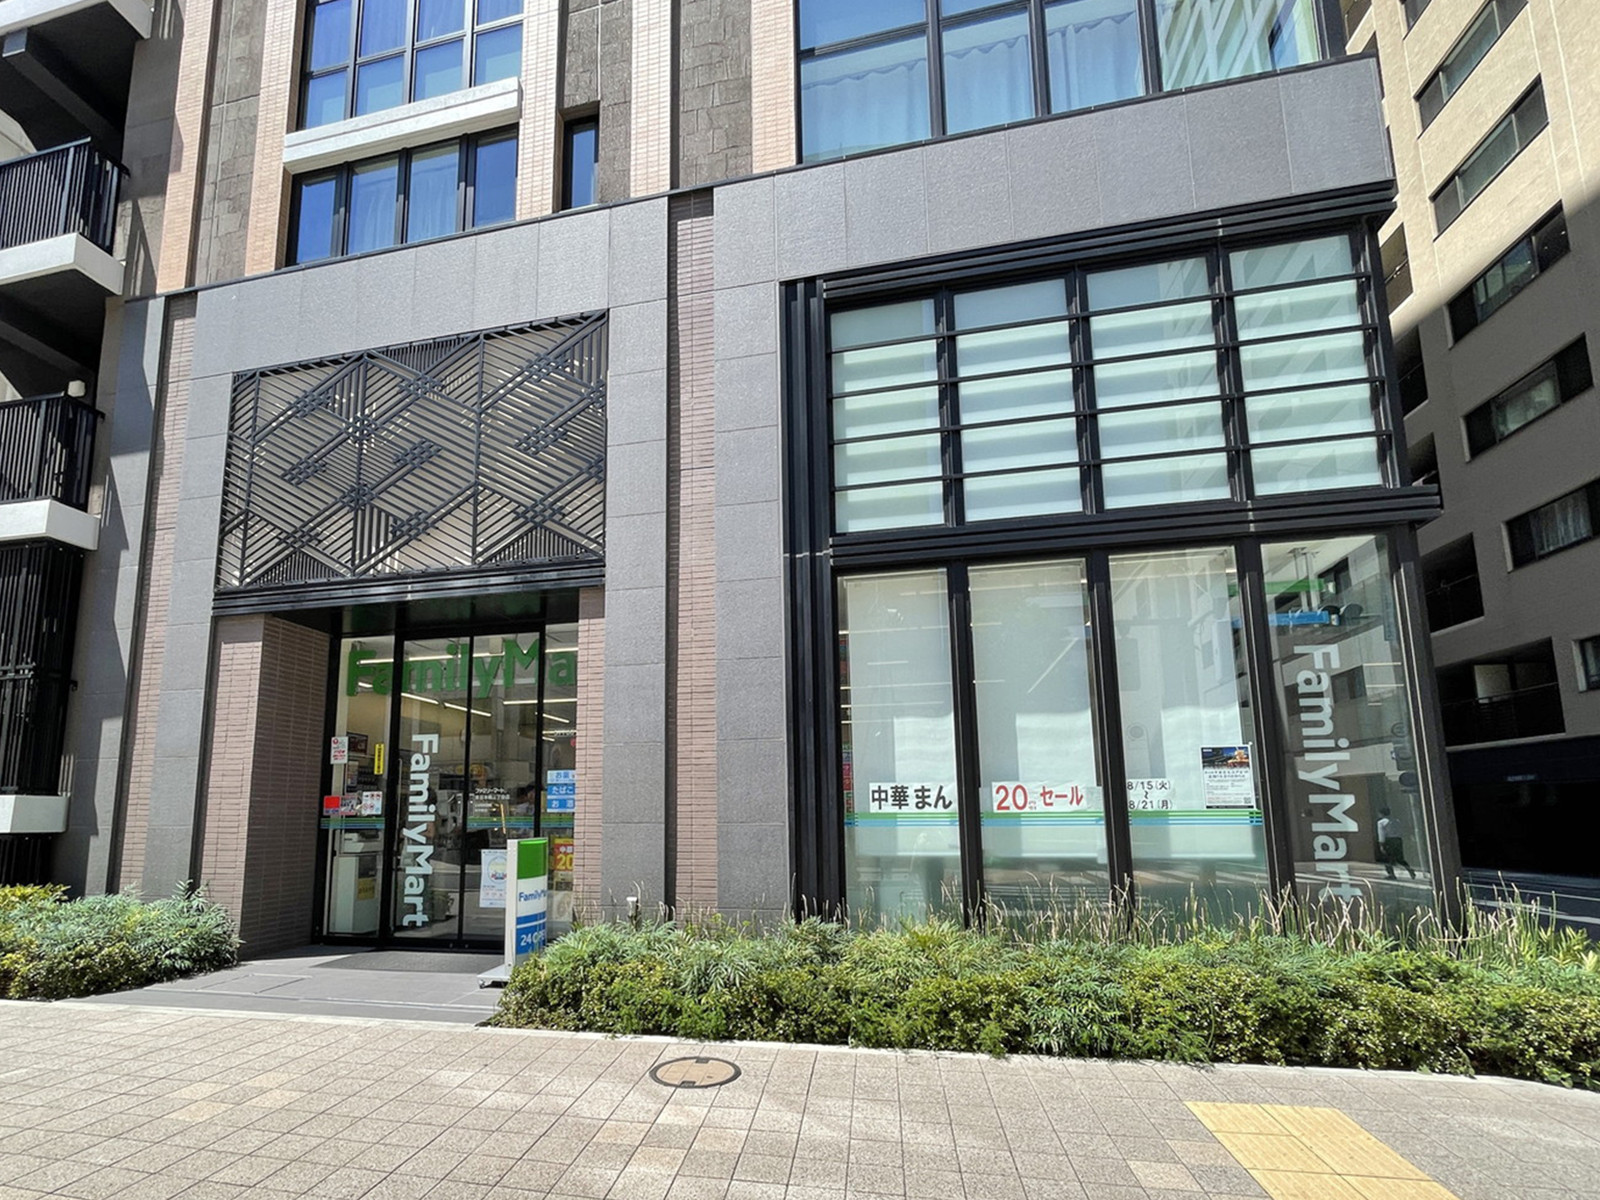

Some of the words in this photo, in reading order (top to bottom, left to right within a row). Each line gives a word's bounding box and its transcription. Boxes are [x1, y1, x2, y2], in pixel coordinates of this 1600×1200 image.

[871, 785, 953, 810] 中華まん
[995, 784, 1028, 811] 20
[1040, 785, 1084, 807] セール
[1293, 643, 1363, 903] FamilyMart
[402, 733, 439, 926] FamilyMart
